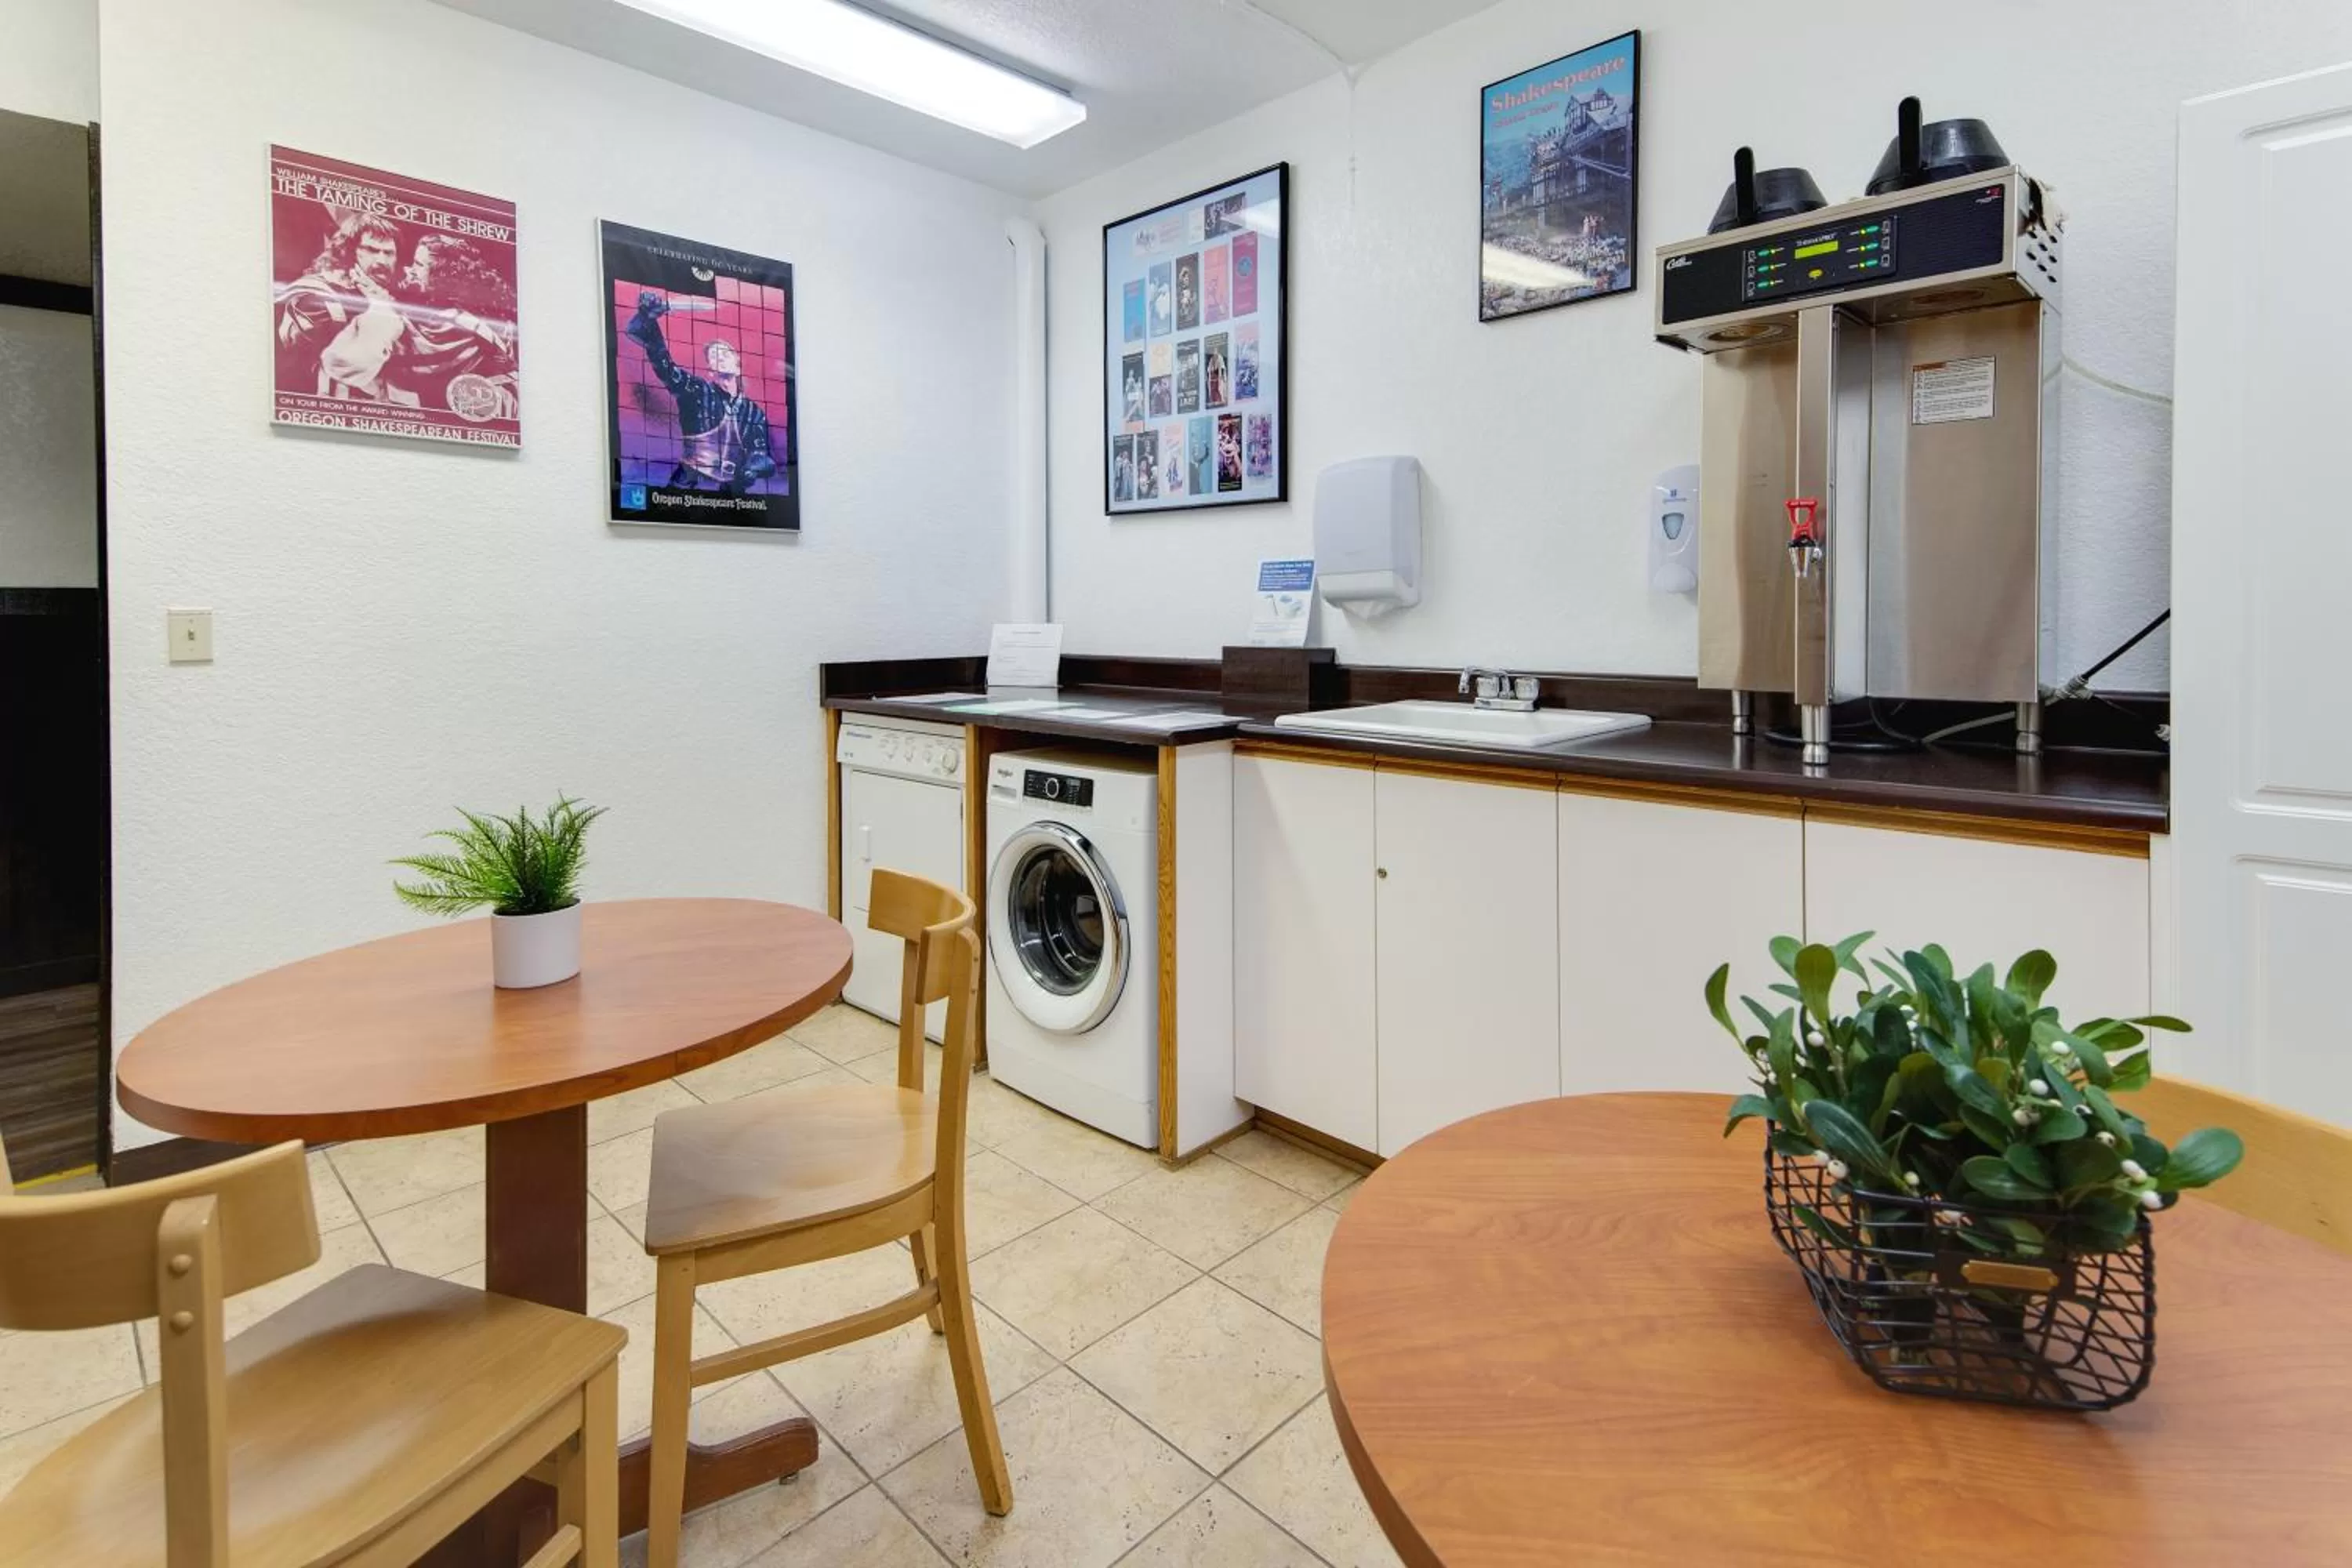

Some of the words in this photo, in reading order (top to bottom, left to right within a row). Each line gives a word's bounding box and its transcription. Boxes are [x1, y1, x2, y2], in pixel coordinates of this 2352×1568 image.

[1492, 56, 1625, 114] Shakespeare
[278, 178, 307, 198] THE
[314, 186, 387, 213] TAMING
[394, 204, 418, 220] OF
[425, 210, 452, 229] THE
[458, 219, 509, 241] SHREW
[320, 401, 344, 411] FROM
[278, 410, 346, 427] OREGON
[352, 418, 462, 441] SHAKESPEAREAN
[467, 430, 518, 446] FESTIVAL
[652, 492, 683, 506] Oregon
[684, 494, 735, 508] Shakespeare
